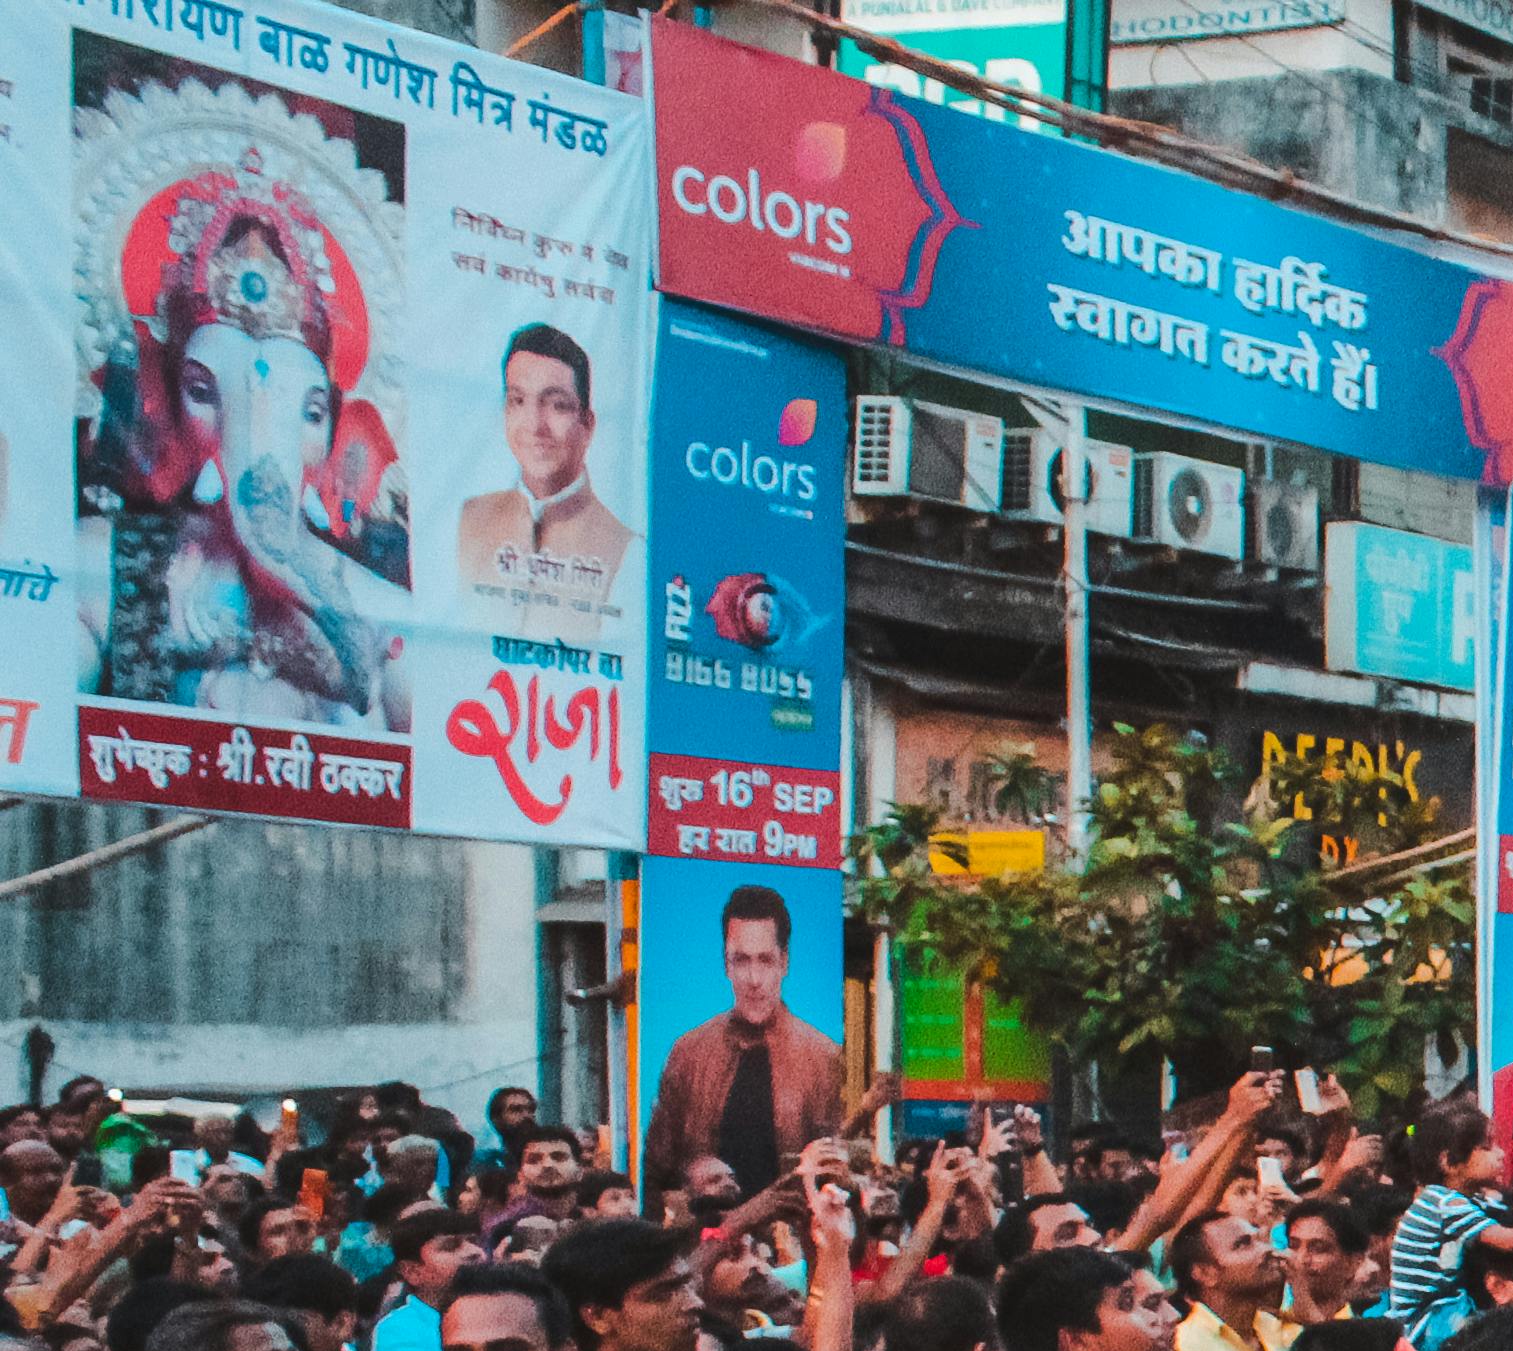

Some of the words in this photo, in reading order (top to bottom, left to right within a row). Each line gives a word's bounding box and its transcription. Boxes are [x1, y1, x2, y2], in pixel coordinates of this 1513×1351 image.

[256, 15, 331, 76] बाळ
[343, 38, 437, 110] गणेश
[450, 61, 516, 133] मित्र
[528, 92, 609, 158] मंडळ
[671, 166, 854, 255] colors
[1062, 207, 1223, 291] आपका
[1231, 254, 1368, 331] हार्दिक
[1047, 281, 1210, 365] स्वागत
[1220, 330, 1320, 395] करते
[684, 439, 817, 501] colors
[319, 750, 405, 800] ठक्कर
[445, 668, 624, 827] राजा
[678, 824, 711, 854] हर
[763, 820, 817, 859] 9PM
[774, 782, 834, 814] SEP
